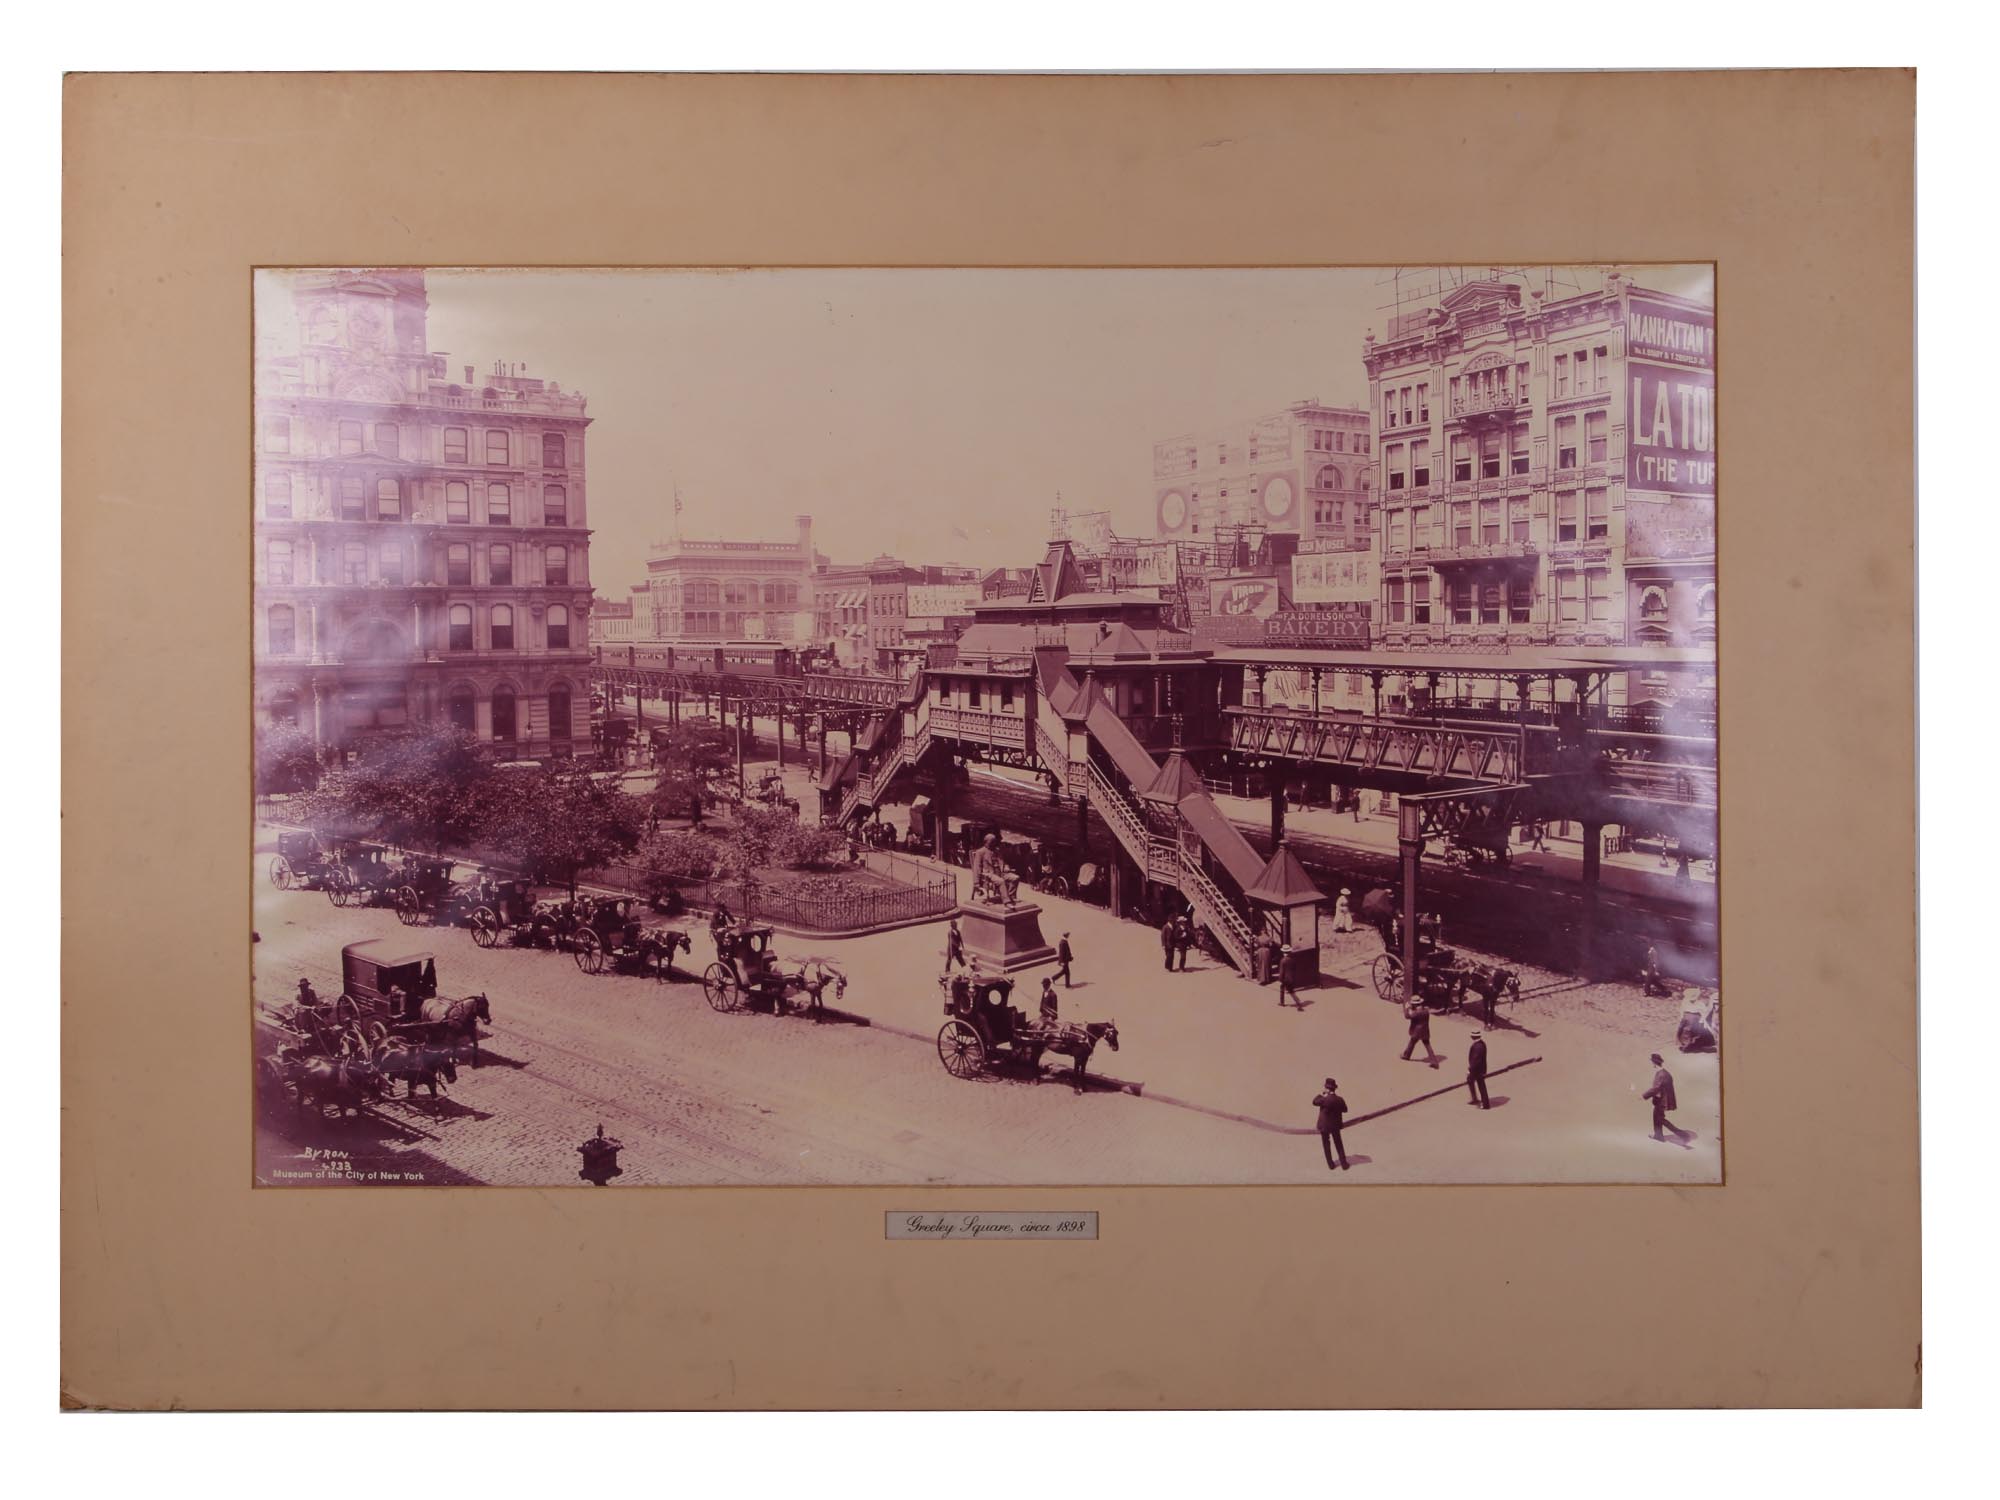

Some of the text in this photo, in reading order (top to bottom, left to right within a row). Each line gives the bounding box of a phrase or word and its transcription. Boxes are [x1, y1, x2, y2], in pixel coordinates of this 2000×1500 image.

[1630, 312, 1704, 354] MANHATTAN
[1268, 620, 1364, 636] BAKERY
[906, 1215, 1086, 1239] Greeley Square, circa 1898
